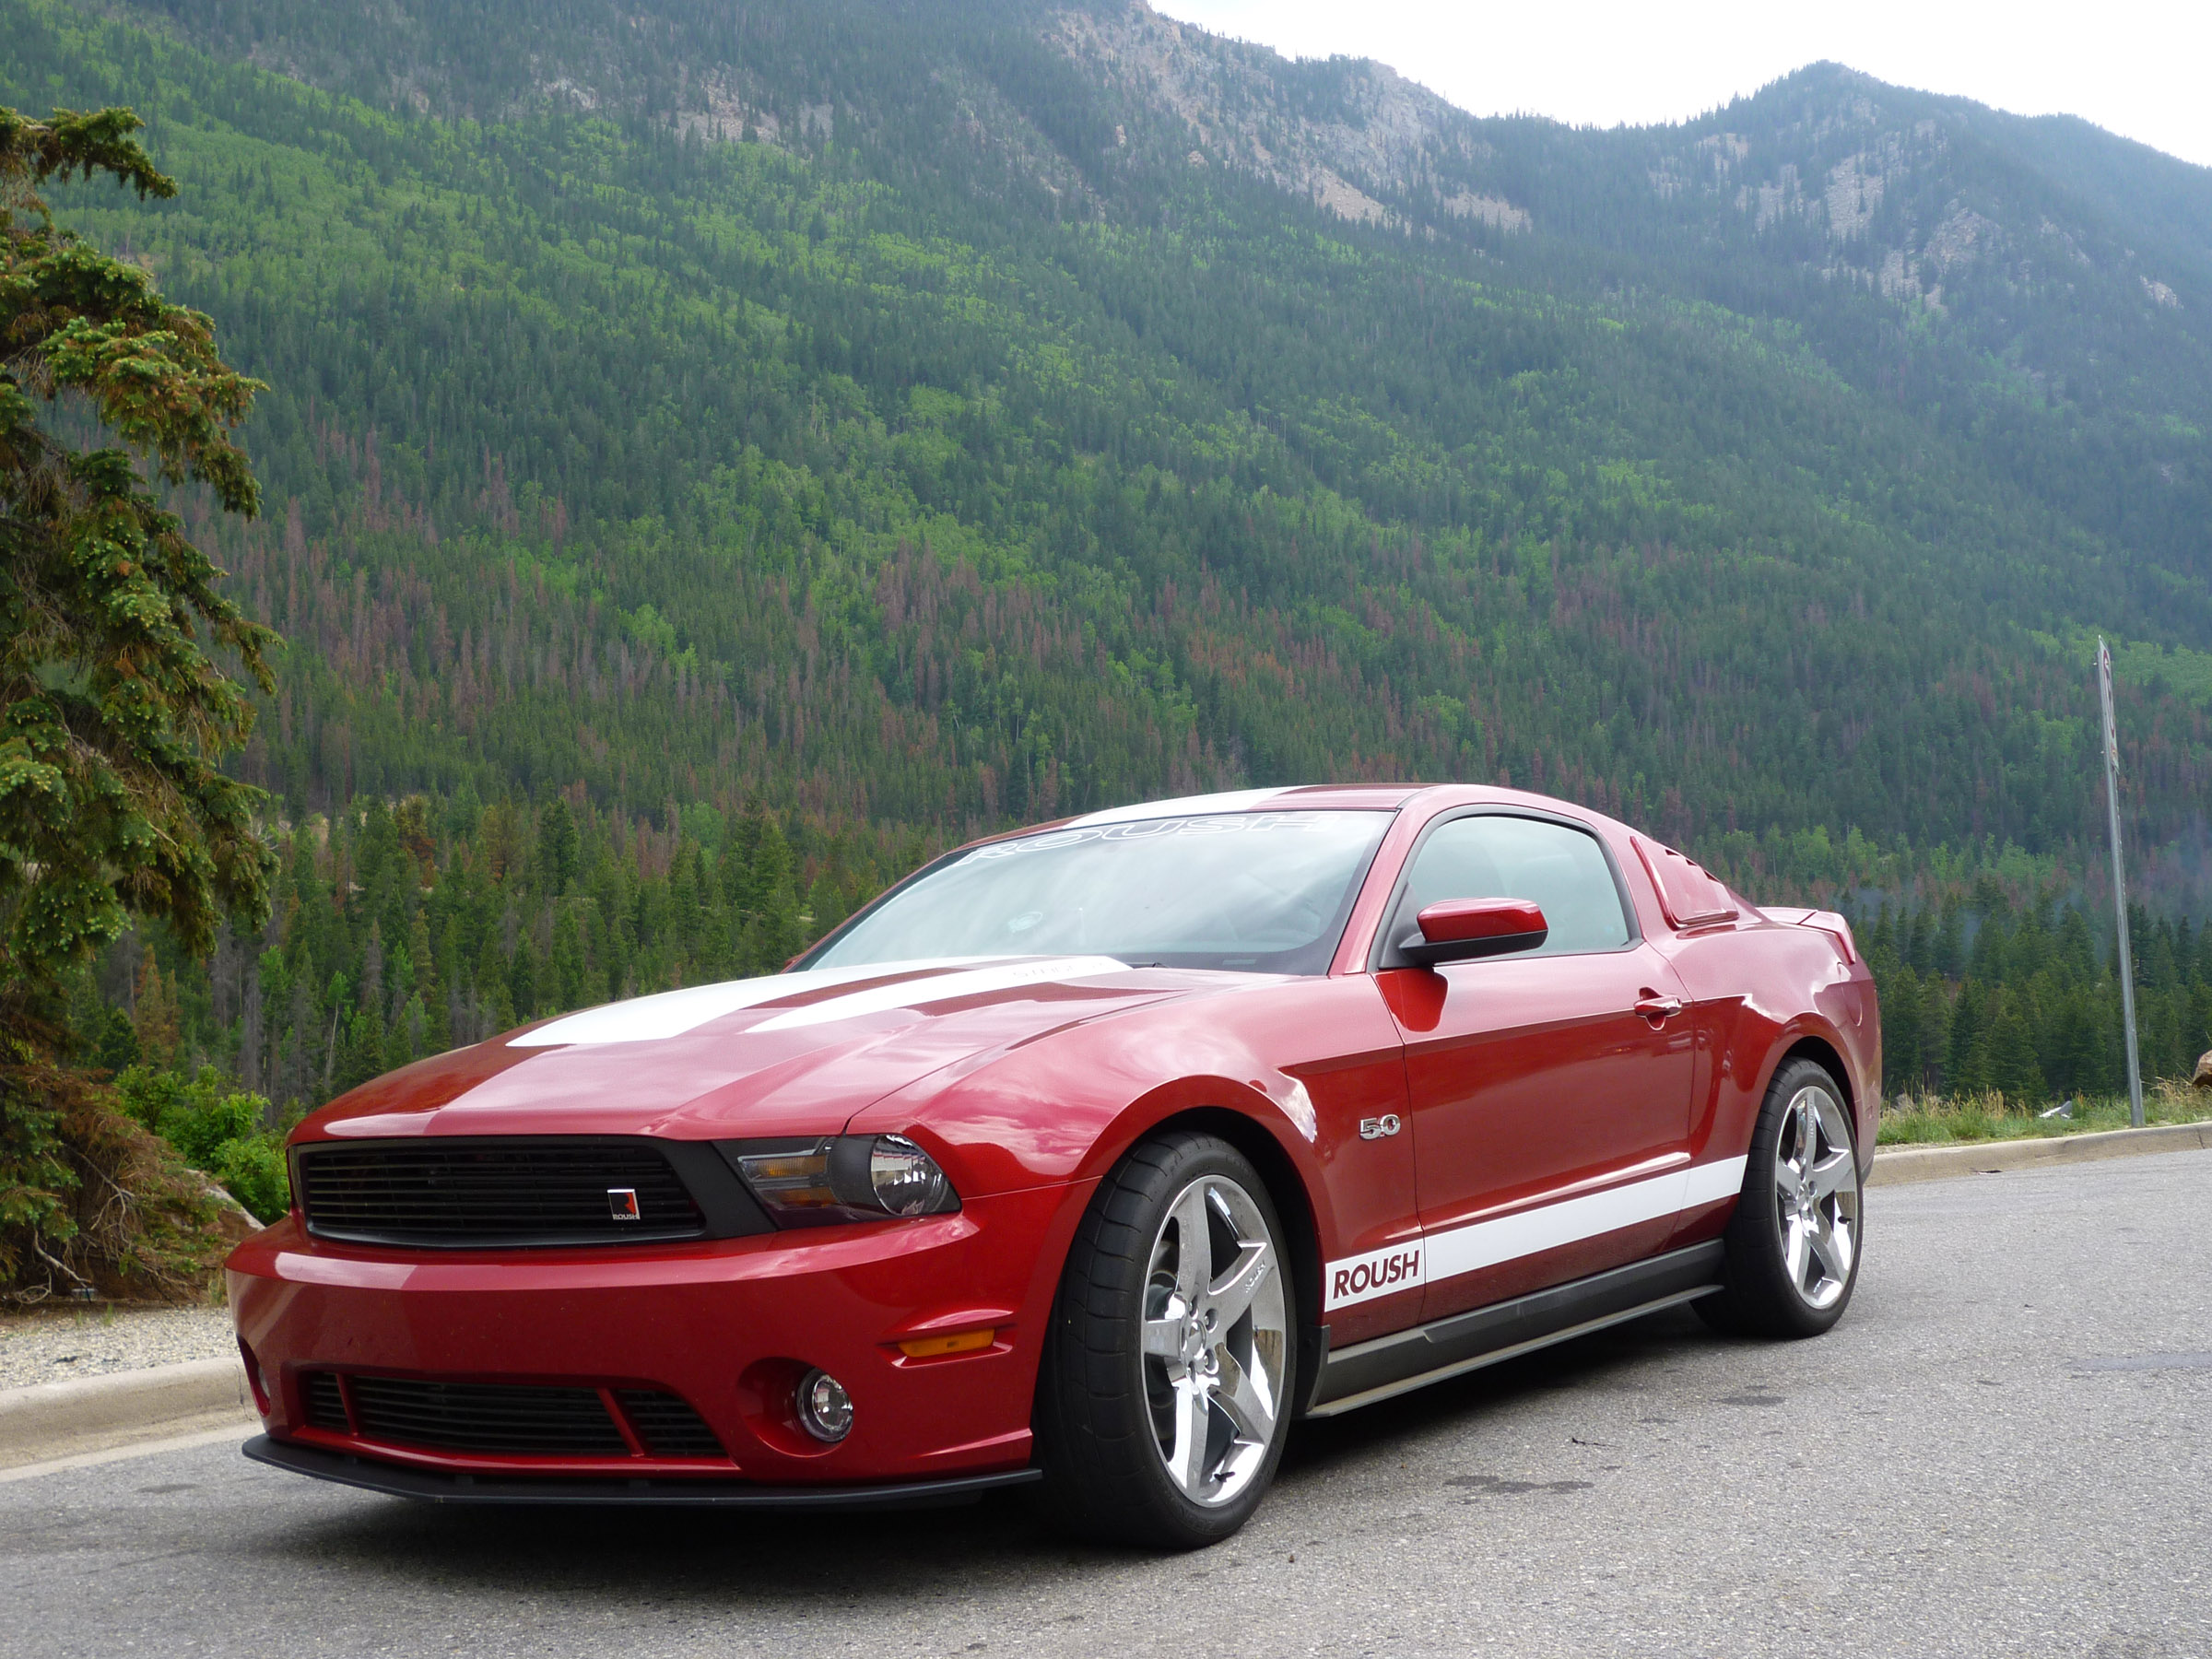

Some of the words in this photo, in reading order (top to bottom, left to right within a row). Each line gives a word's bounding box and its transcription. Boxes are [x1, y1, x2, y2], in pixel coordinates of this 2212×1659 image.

[952, 814, 1341, 866] ROUSH
[1359, 1113, 1400, 1140] 5.0
[1333, 1249, 1419, 1300] ROUSH
